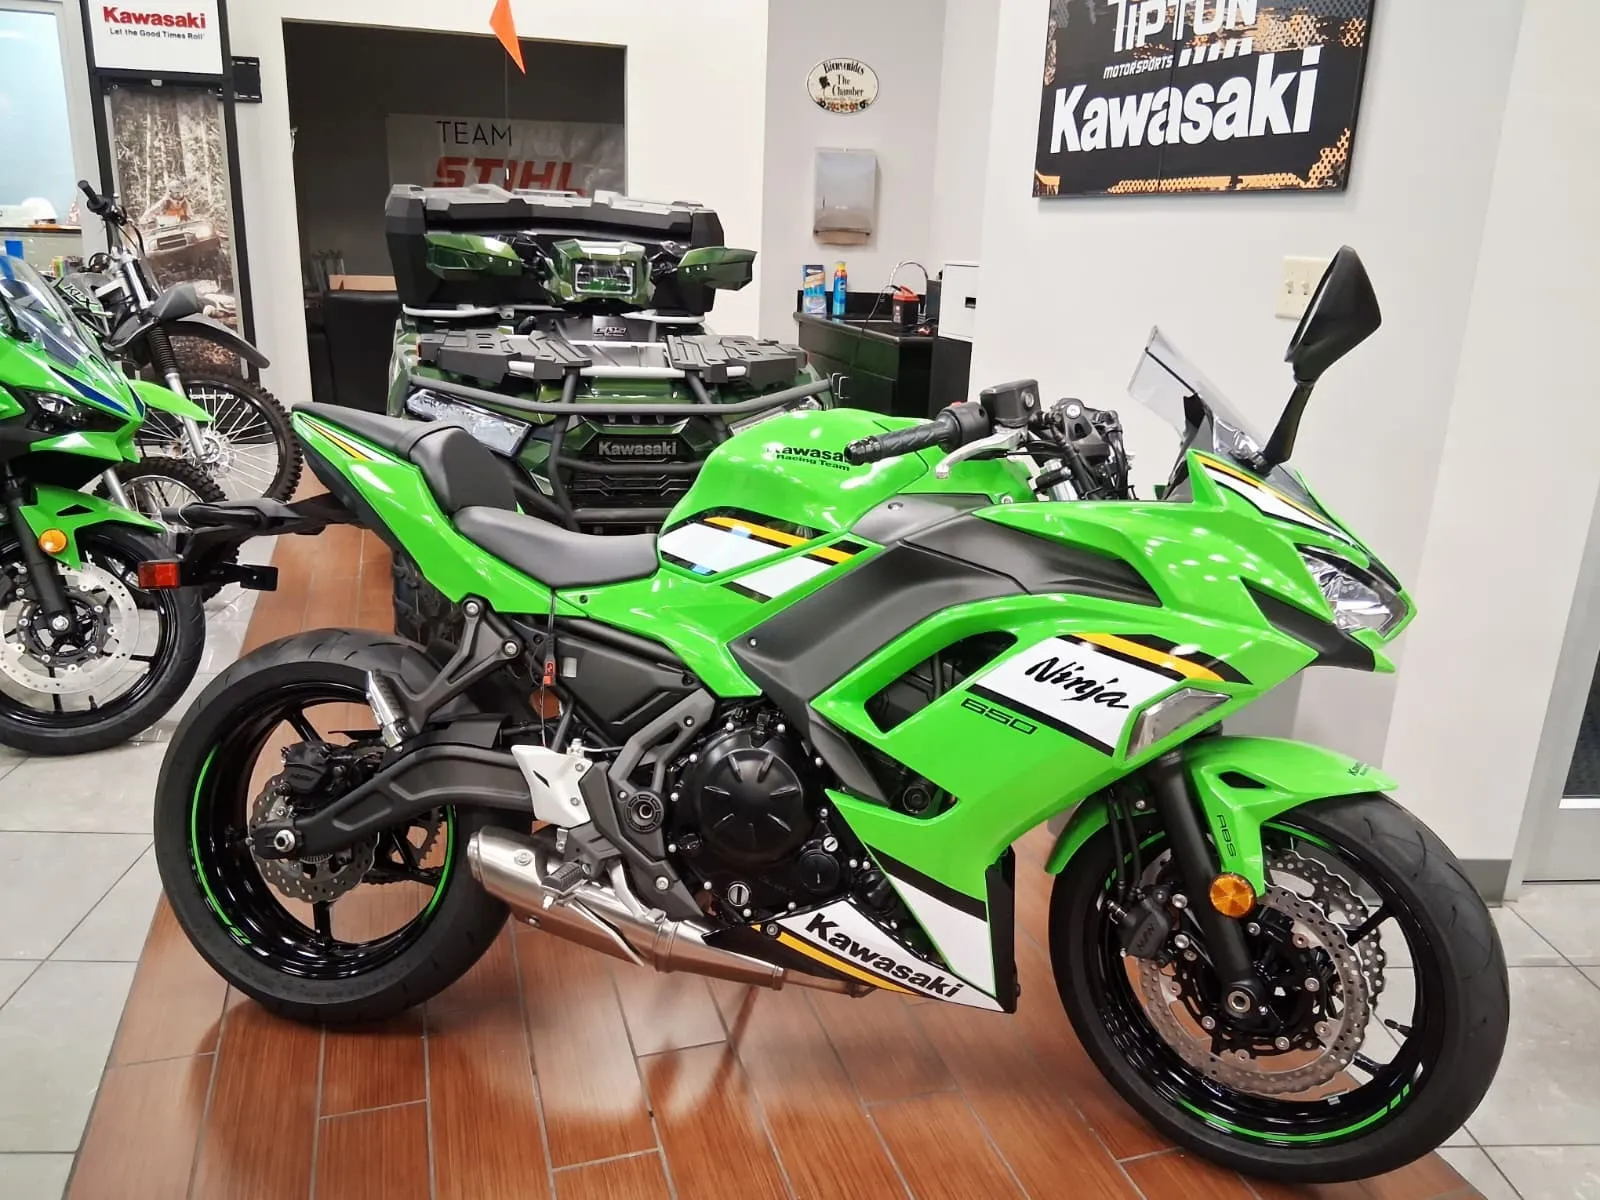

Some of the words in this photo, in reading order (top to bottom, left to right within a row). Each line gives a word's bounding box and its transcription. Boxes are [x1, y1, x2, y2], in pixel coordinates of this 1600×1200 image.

[103, 6, 206, 28] Kawasaki
[109, 27, 123, 35] Let
[139, 30, 161, 38] Good
[163, 31, 186, 39] Times
[837, 74, 850, 85] The
[1103, 55, 1175, 80] MOTORSPORTS
[832, 84, 864, 96] Chamber
[1050, 44, 1324, 153] Kawasaki
[436, 120, 512, 147] TEAM
[433, 156, 586, 197] STIHL
[598, 441, 677, 456] Kawasaki
[776, 454, 817, 465] Racing
[819, 460, 850, 471] Team
[1025, 656, 1129, 709] Ninja
[960, 698, 1038, 735] 650
[1216, 814, 1237, 857] ABS
[805, 912, 964, 998] Kawasaki
